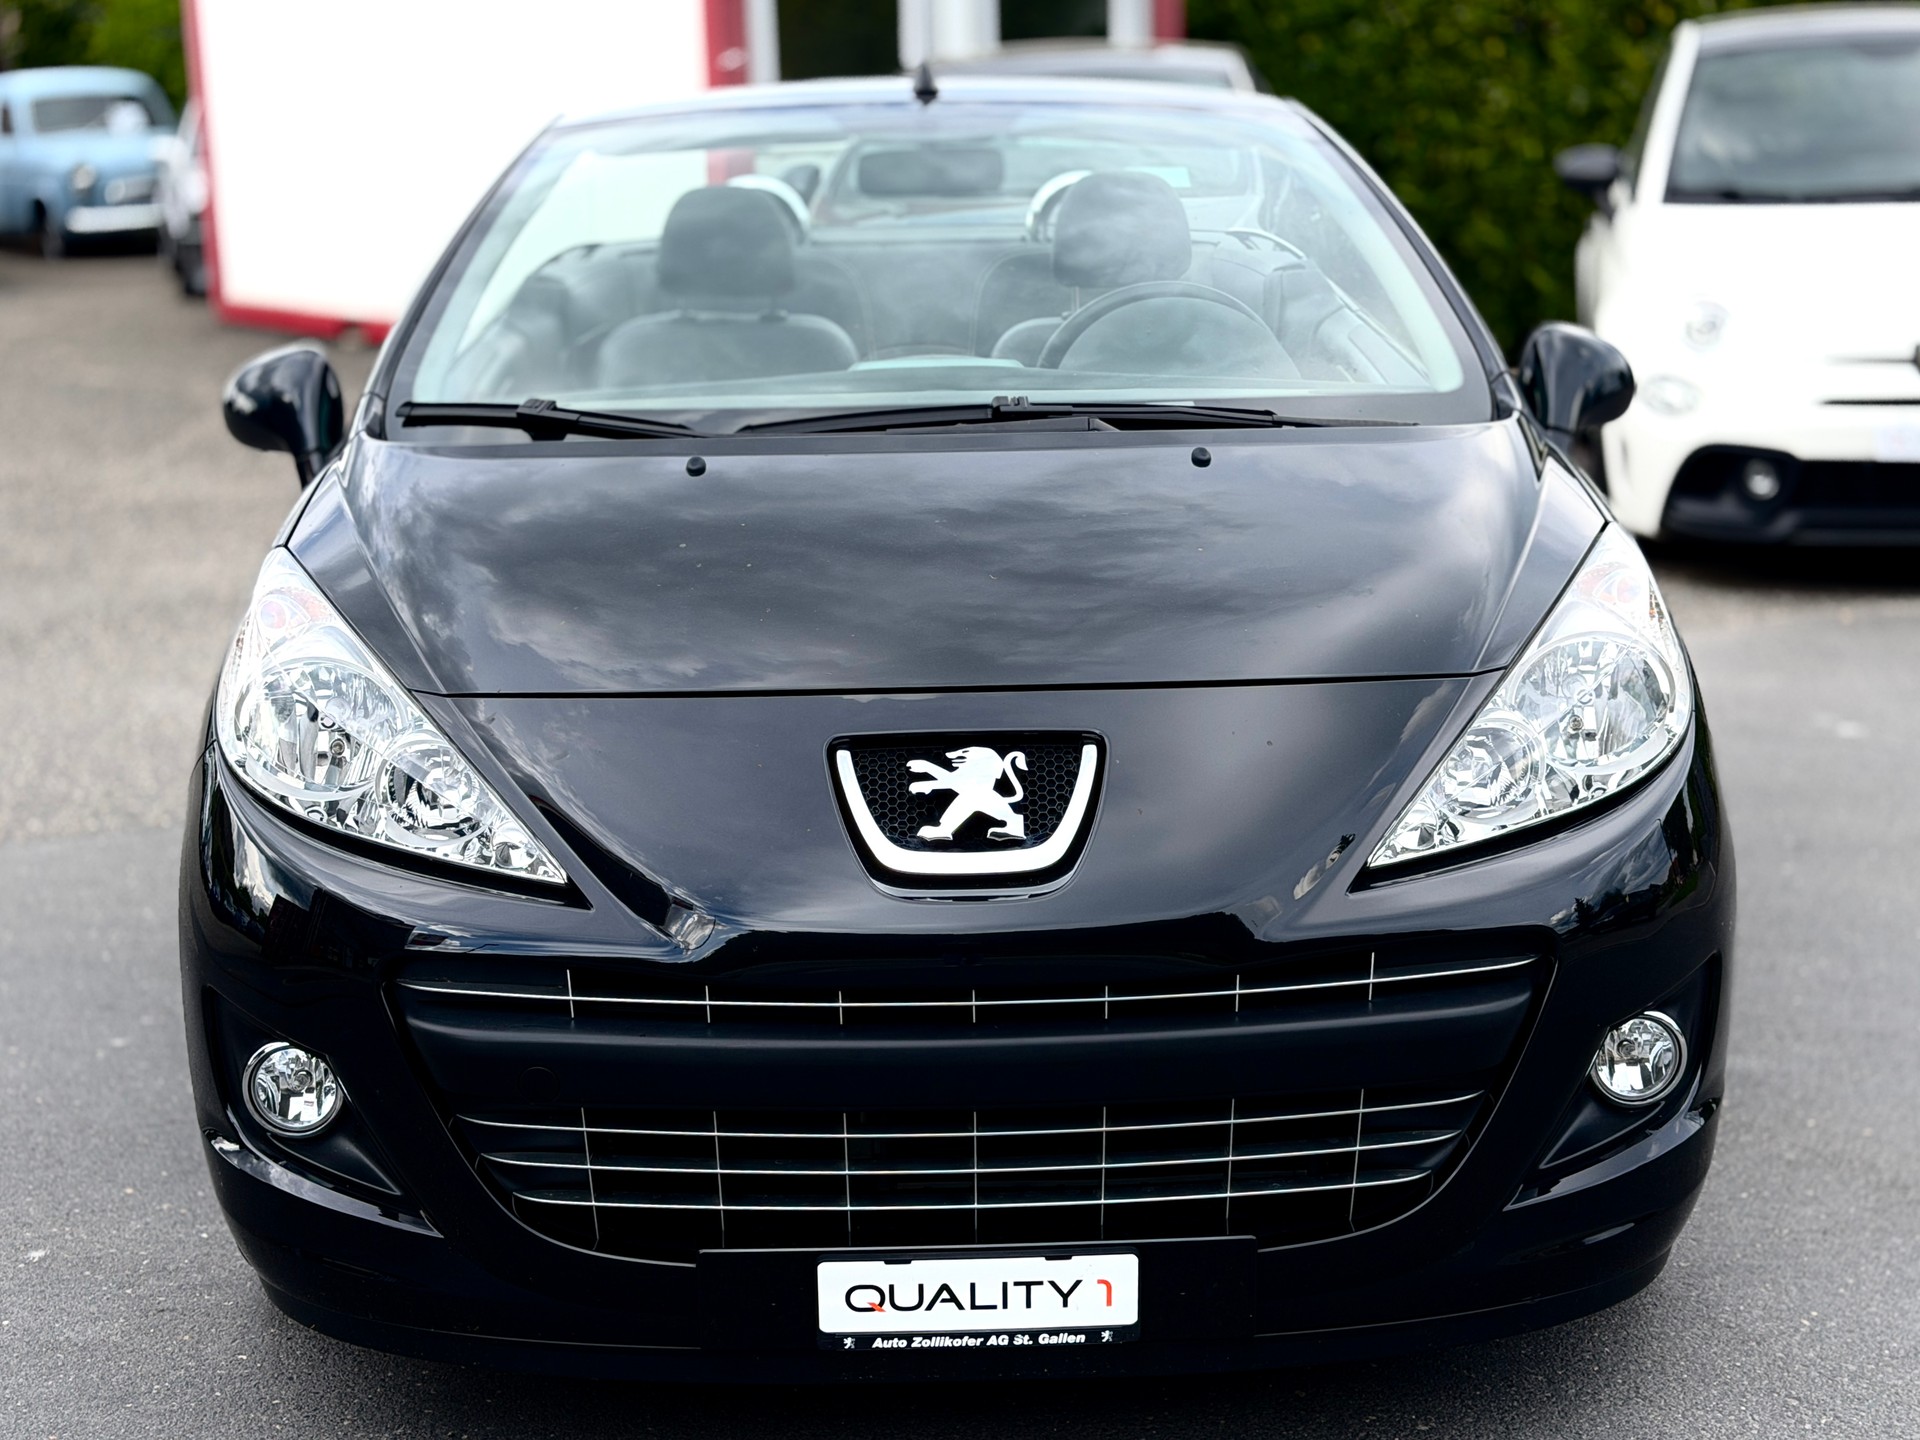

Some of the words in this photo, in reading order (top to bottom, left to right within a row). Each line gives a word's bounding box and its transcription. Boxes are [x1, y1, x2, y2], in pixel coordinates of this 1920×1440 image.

[845, 1279, 1083, 1313] QUALITY
[1097, 1279, 1112, 1307] 1
[872, 1337, 907, 1349] Auto
[911, 1335, 983, 1348] Zollikofer
[987, 1335, 1009, 1347] AG
[1013, 1334, 1033, 1346] St.
[1038, 1332, 1086, 1345] Gallen
